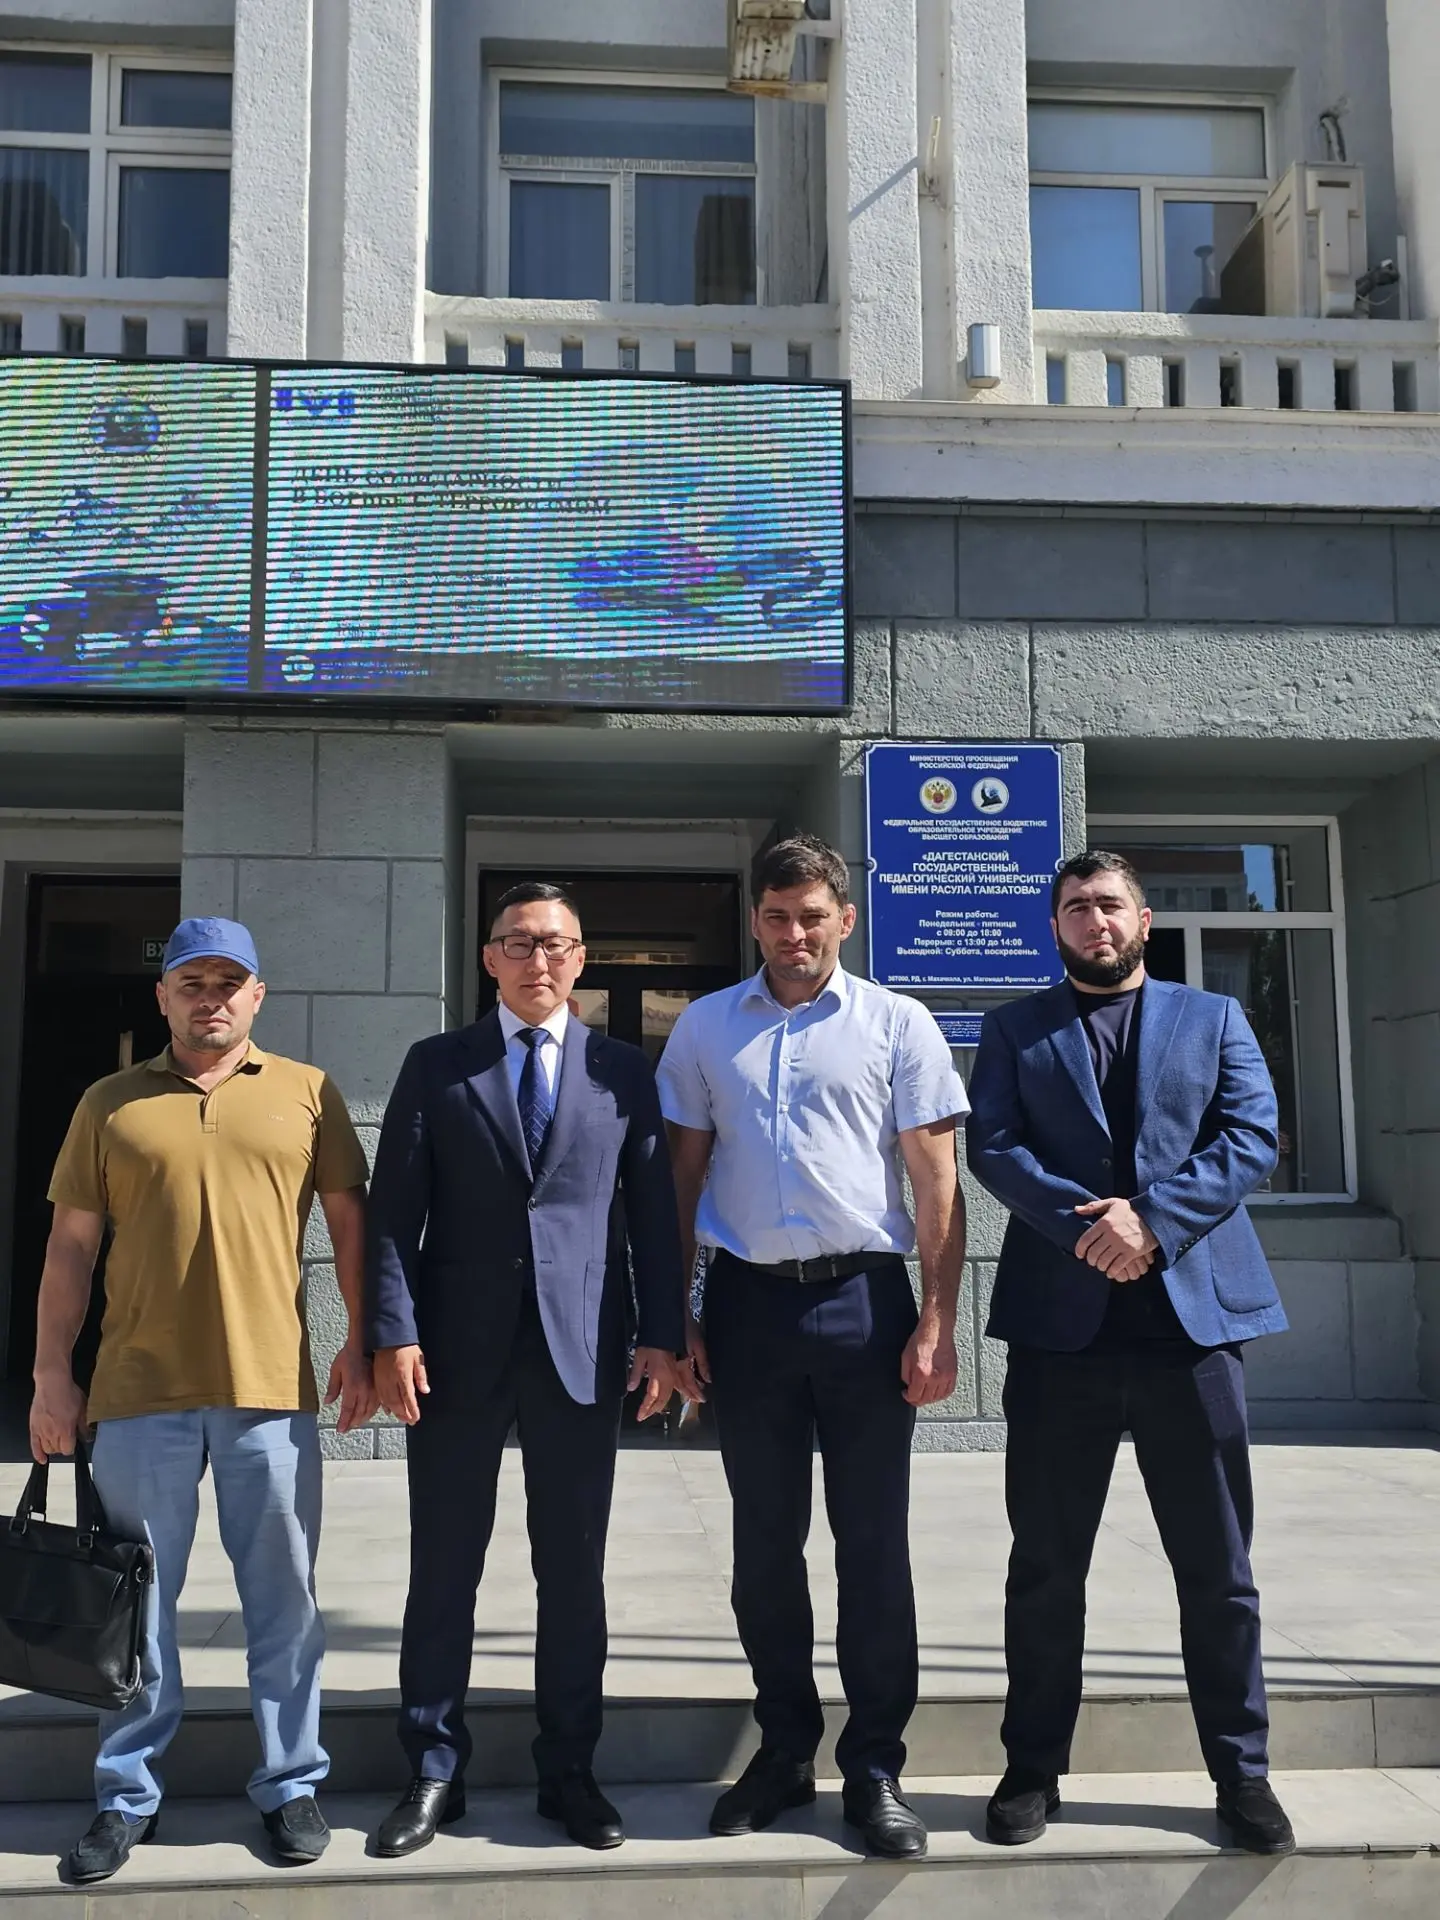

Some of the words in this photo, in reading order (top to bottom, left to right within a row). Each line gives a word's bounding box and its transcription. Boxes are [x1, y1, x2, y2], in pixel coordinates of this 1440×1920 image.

[909, 755, 965, 763] МИНИСТЕРСТВО
[965, 755, 1019, 763] ПРОСВЕЩЕНИЯ
[918, 762, 966, 770] РОССИЙСКОЙ
[966, 762, 1009, 770] ФЕДЕРАЦИИ
[883, 819, 934, 827] ФЕДЕРАЛЬНОЕ
[935, 819, 1002, 827] ГОСУДАРСТВЕННОЕ
[1003, 819, 1048, 827] БЮДЖЕТНОЕ
[908, 826, 975, 834] ОБРАЗОВАТЕЛЬНОЕ
[976, 826, 1023, 834] УЧРЕЖДЕНИЕ
[922, 833, 958, 841] ВЫСШЕГО
[959, 833, 1010, 841] ОБРАЗОВАНИЯ
[922, 850, 1009, 862] «ДАГЕСТАНСКИЙ
[913, 862, 1019, 873] ГОСУДАРСТВЕННЫЙ
[879, 872, 976, 884] ПЕДАГОГИЧЕСКИЙ
[977, 873, 1053, 884] УНИВЕРСИТЕТ
[891, 885, 929, 895] ИМЕНИ
[930, 885, 972, 895] РАСУЛА
[973, 885, 1041, 895] ГАМЗАТОВА»
[935, 910, 963, 919] Режим
[964, 910, 999, 920] работы:
[918, 919, 975, 929] Понедельник
[981, 920, 1017, 929] пятница
[966, 929, 979, 937] до
[980, 929, 1002, 937] 18:00
[914, 938, 955, 947] Перерыв:
[964, 938, 986, 946] 13:00
[986, 938, 999, 947] до
[1000, 938, 1023, 946] 14:00
[896, 946, 944, 956] Выходной:
[945, 947, 982, 957] Суббота,
[984, 948, 1040, 957] воскресенье.
